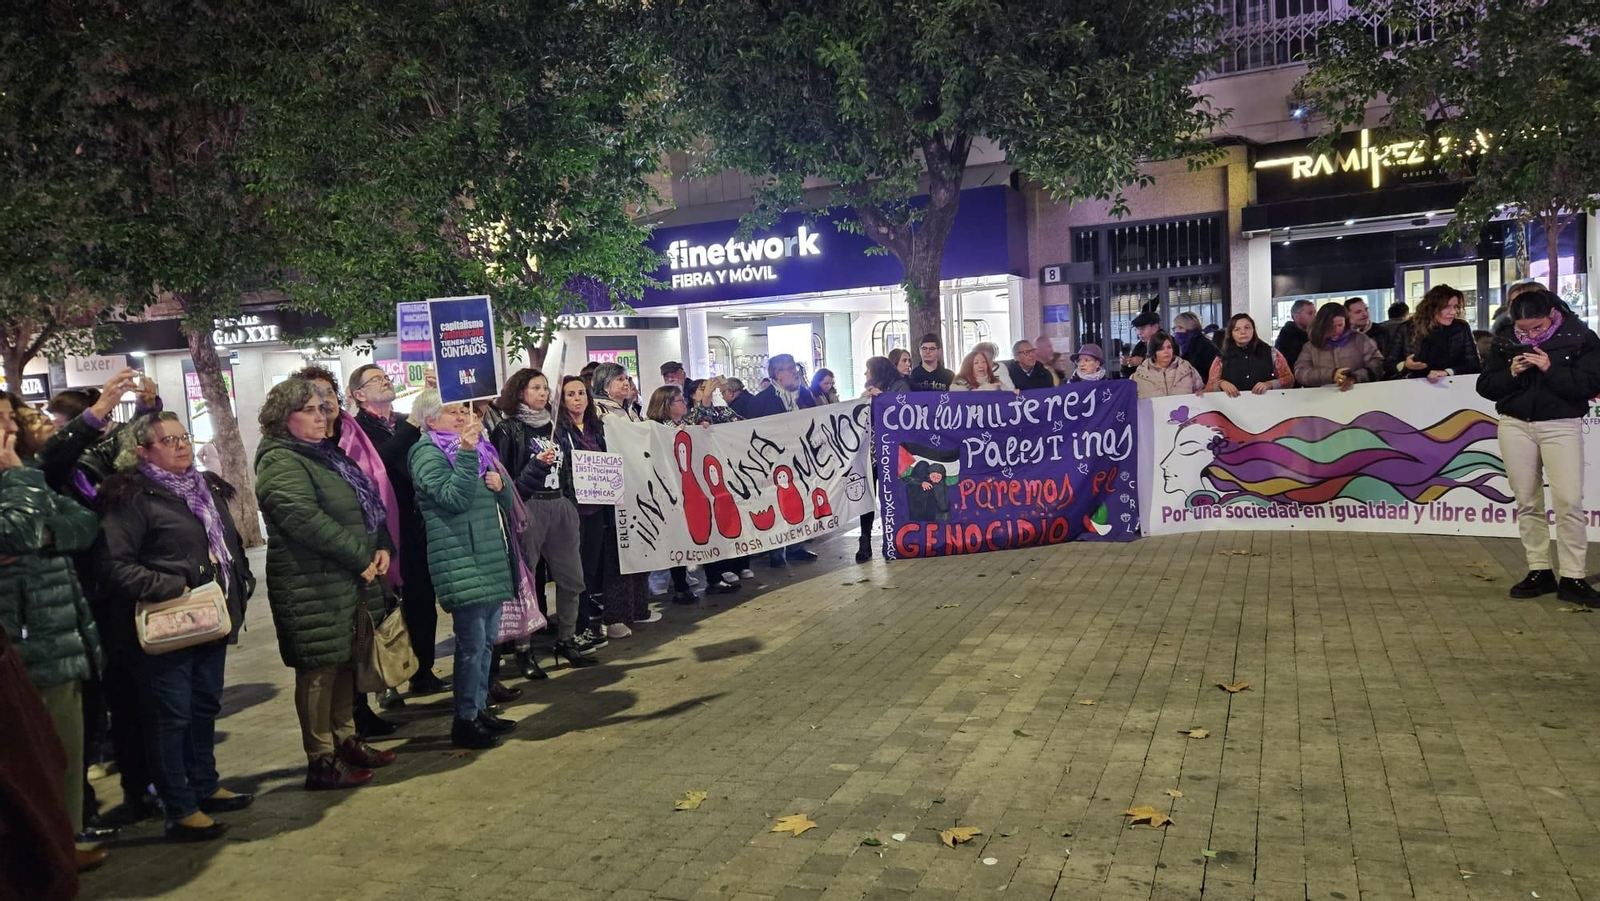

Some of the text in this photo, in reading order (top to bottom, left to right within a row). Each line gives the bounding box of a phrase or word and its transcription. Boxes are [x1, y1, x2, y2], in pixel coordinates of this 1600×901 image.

[1402, 170, 1433, 178] DESDE
[667, 226, 821, 270] finetwork
[672, 266, 777, 288] FIBRA Y MÓVIL
[1049, 269, 1056, 280] 8
[440, 320, 484, 331] capitalismo
[593, 316, 625, 329] XXI
[245, 325, 279, 343] XXI
[441, 344, 488, 358] CONTADOS
[381, 363, 405, 375] LACK
[185, 375, 201, 388] BLA
[1161, 505, 1189, 523] Por
[1193, 505, 1222, 520] una
[1226, 502, 1299, 519] sociedad
[1303, 505, 1325, 519] en
[1329, 501, 1409, 523] igualdad
[1413, 505, 1425, 525] y
[1429, 503, 1477, 522] libre
[1481, 503, 1507, 524] de
[669, 515, 840, 565] COLECTIVO ROSA LUXEMBURGO
[896, 517, 1069, 558] GENOCIDIO
